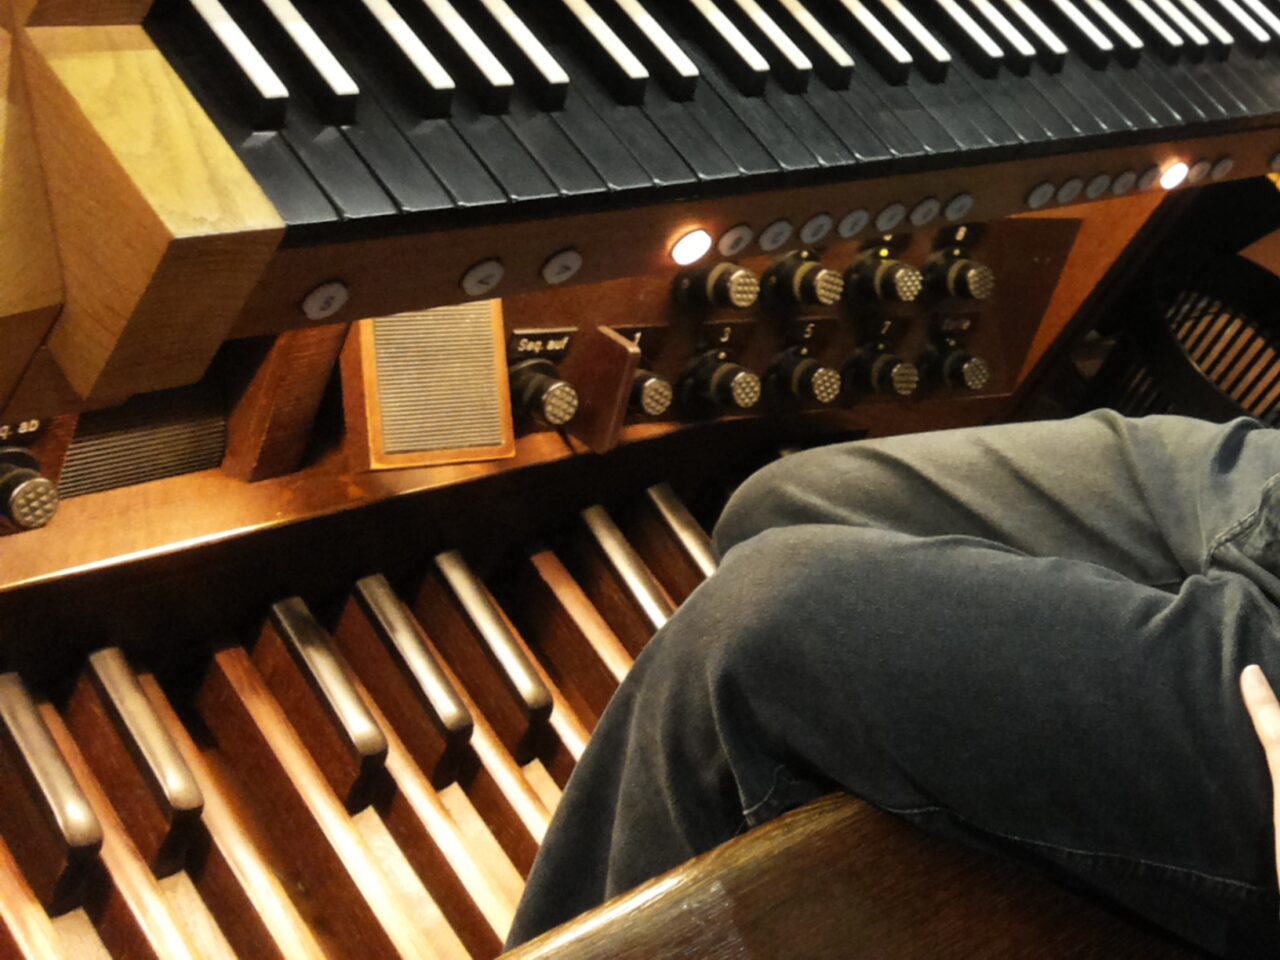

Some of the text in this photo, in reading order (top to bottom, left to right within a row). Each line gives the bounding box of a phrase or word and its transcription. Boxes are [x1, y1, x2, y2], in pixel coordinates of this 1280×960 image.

[720, 327, 731, 341] 3
[804, 323, 815, 338] 5
[18, 419, 40, 434] ab
